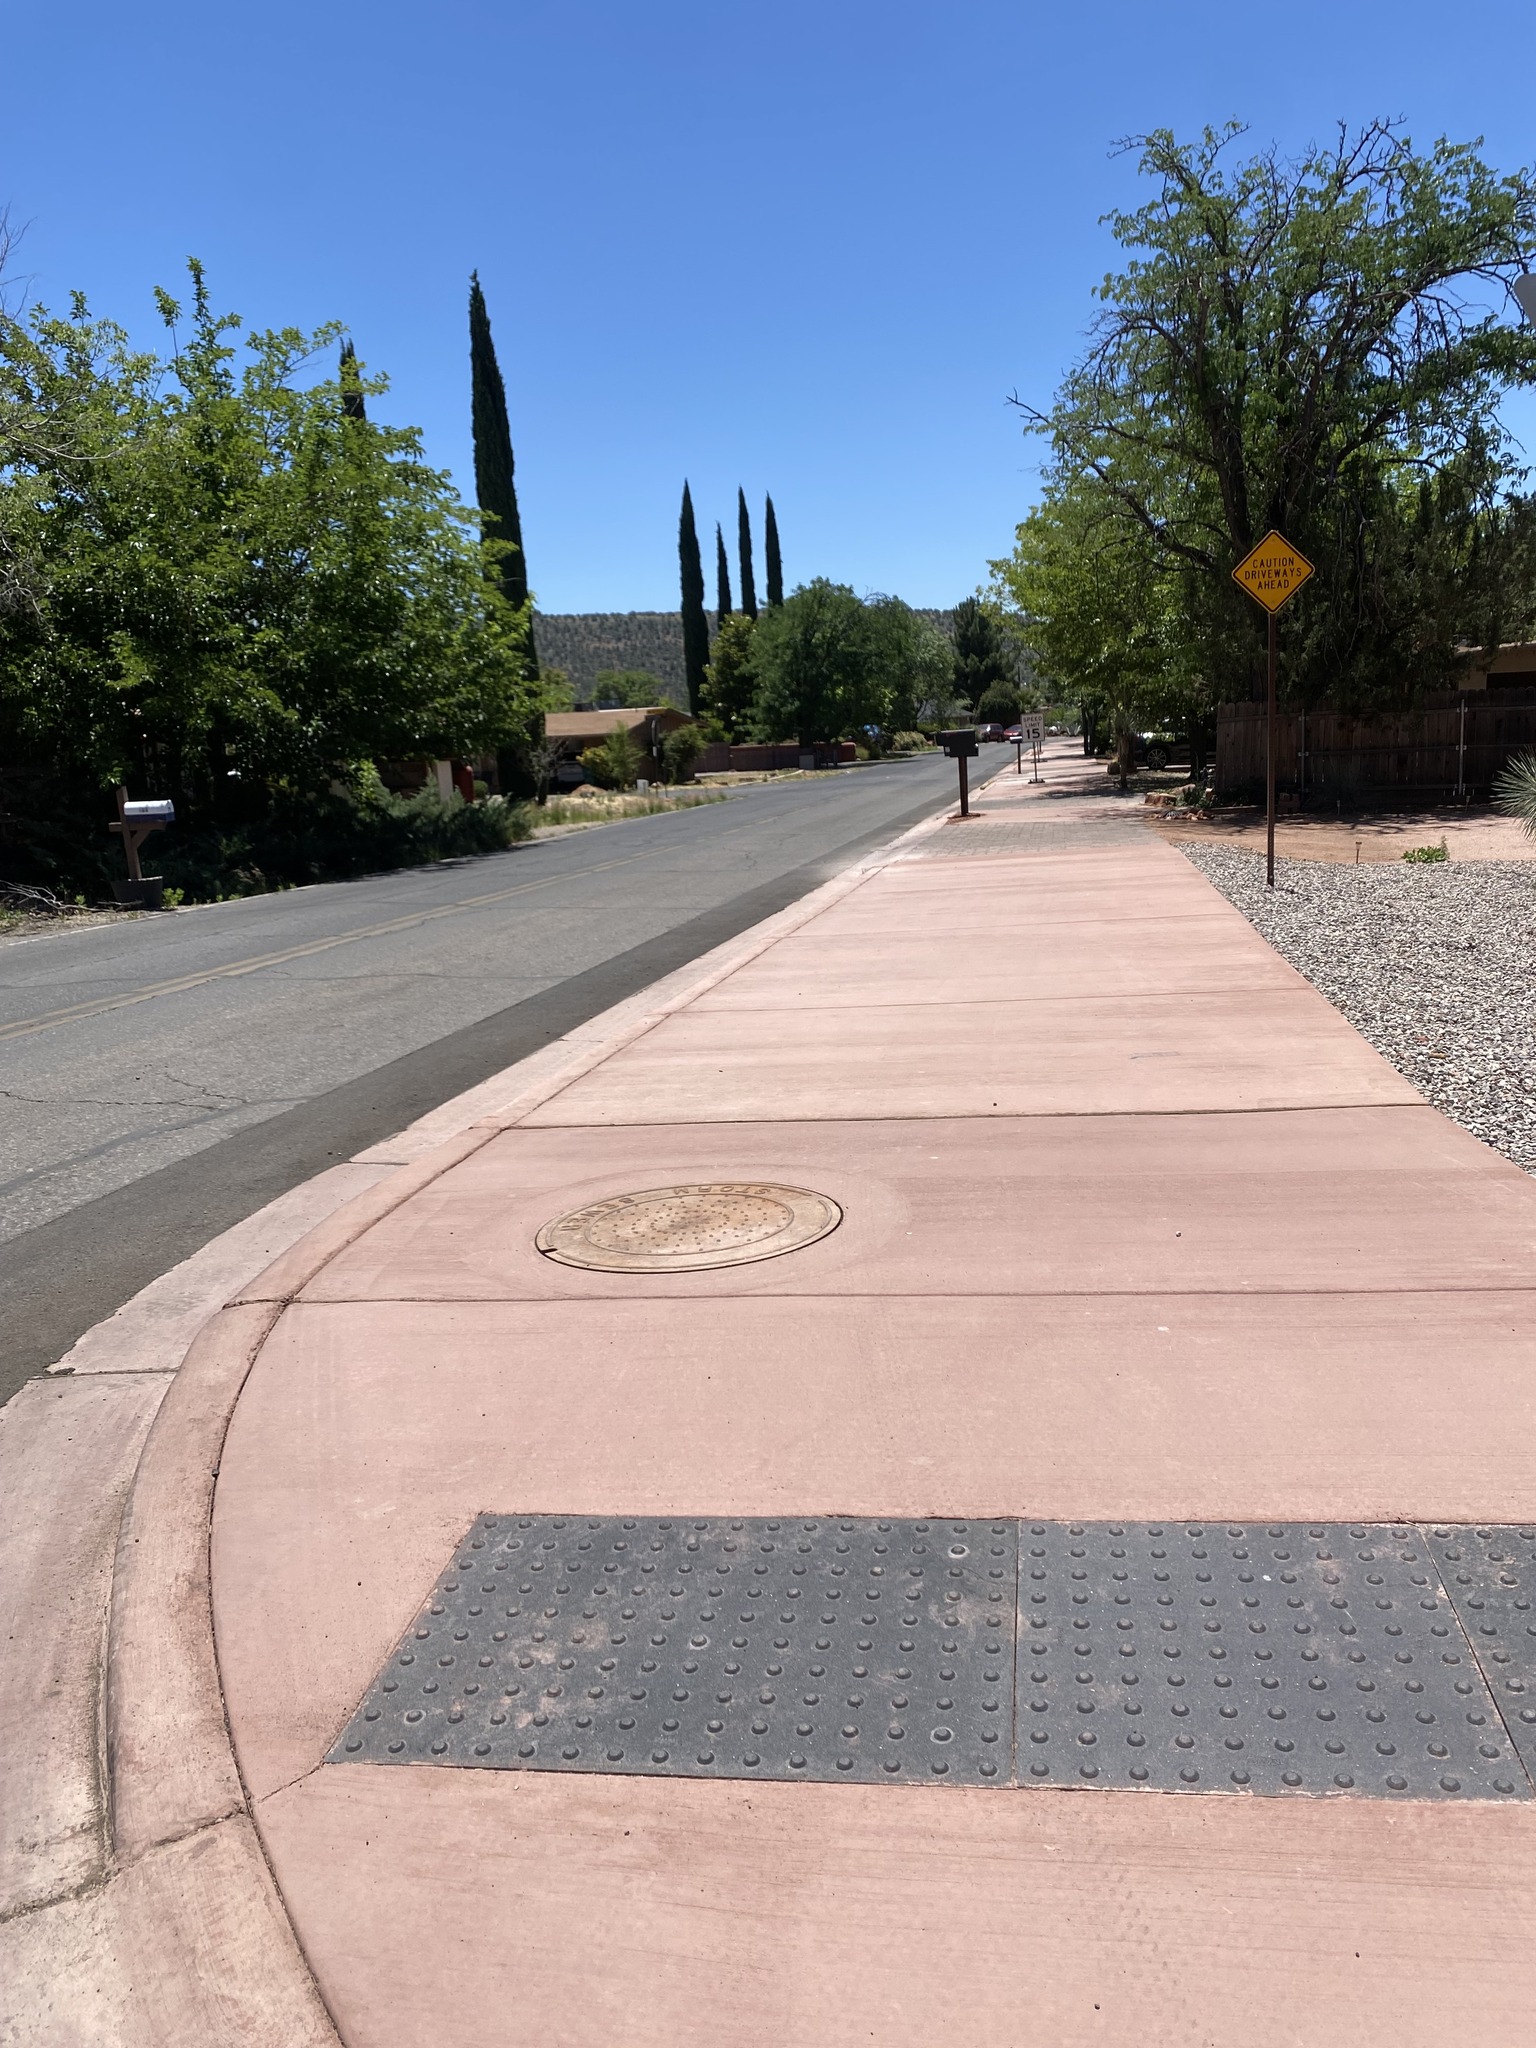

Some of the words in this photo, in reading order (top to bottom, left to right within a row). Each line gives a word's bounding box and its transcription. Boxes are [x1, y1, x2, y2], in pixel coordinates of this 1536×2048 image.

[1252, 557, 1294, 568] CAUTION
[1244, 567, 1302, 580] DRIVEWAYS
[1257, 579, 1290, 590] AHEAD
[1026, 728, 1040, 739] 15
[673, 1186, 771, 1195] STORM
